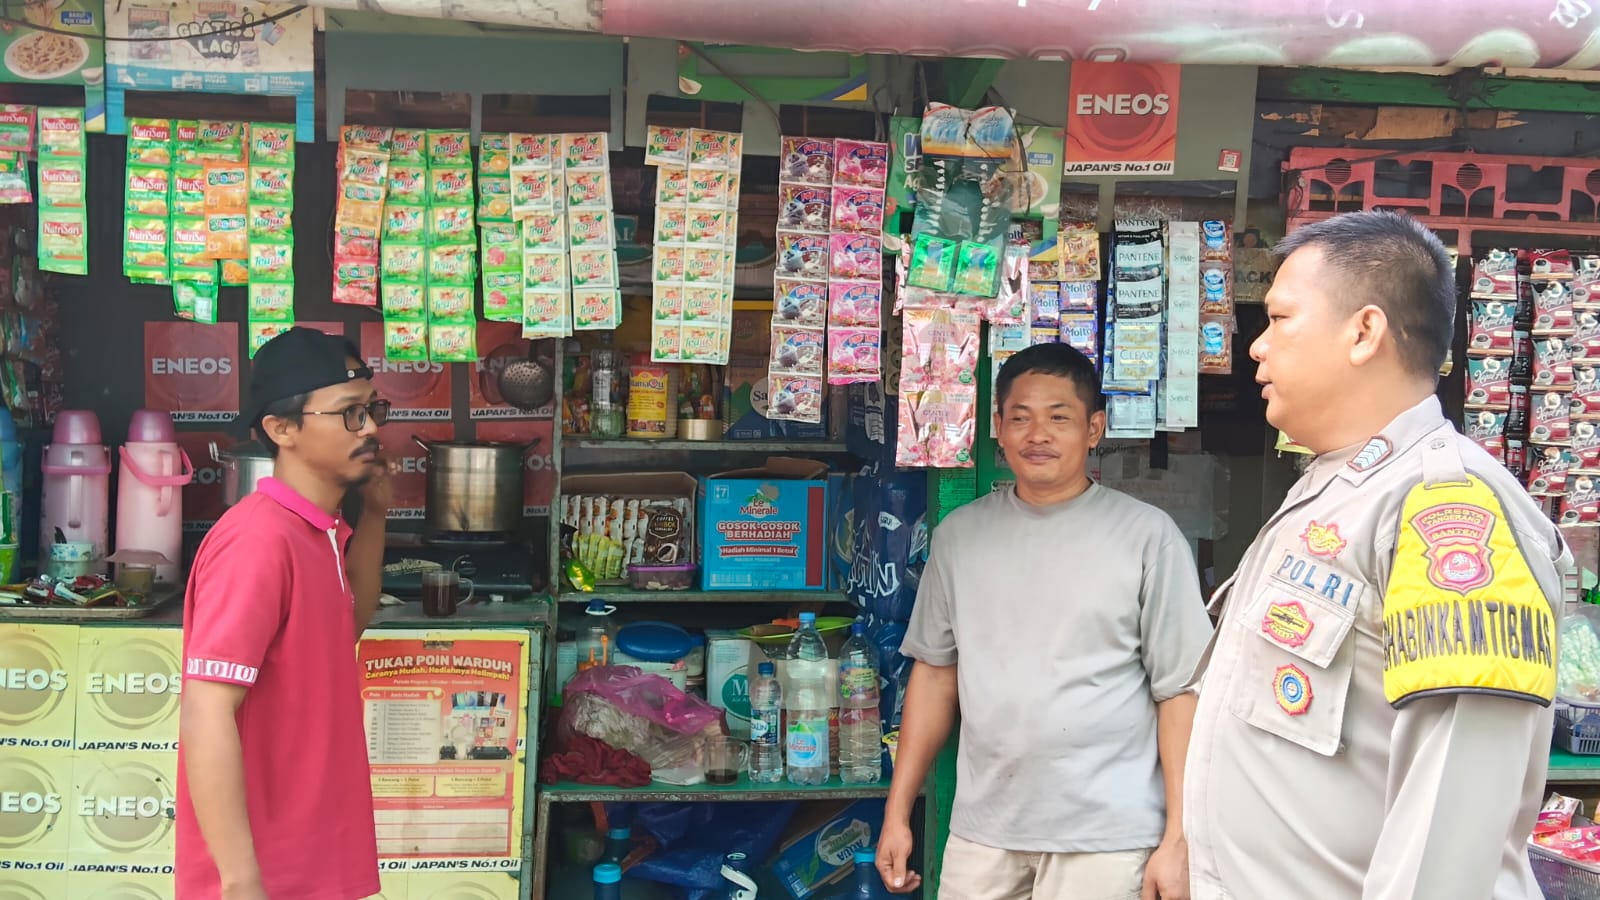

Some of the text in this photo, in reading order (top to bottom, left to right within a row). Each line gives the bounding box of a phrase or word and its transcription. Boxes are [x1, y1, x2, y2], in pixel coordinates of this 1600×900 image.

[1076, 94, 1169, 115] ENEOS
[41, 118, 80, 131] NutriSari
[133, 125, 168, 140] NutriSari
[1066, 162, 1171, 173] JAPAN'S No.1 Oil
[41, 169, 80, 182] NutriSari
[131, 177, 167, 192] NutriSari
[43, 222, 80, 235] NutriSari
[1116, 219, 1158, 227] PANTENE
[129, 229, 165, 241] NutriSari
[1118, 252, 1160, 262] PANTENE
[1234, 270, 1272, 283] ACK
[1118, 289, 1160, 298] PANTENE
[1064, 326, 1092, 336] Molto
[1119, 349, 1154, 360] CLEAR
[152, 357, 232, 375] ENEOS
[367, 356, 444, 374] ENEOS
[171, 412, 237, 420] AN'S No.1 Oil
[411, 409, 449, 417] No.1 Oil
[472, 408, 517, 417] JAPAN'S
[753, 498, 765, 507] Le
[740, 505, 778, 515] Minerale
[1421, 508, 1485, 523] POLRESTA
[1429, 514, 1482, 526] TANGERANG
[718, 522, 800, 531] GOSOK-GOSOK
[726, 531, 791, 539] BERHADIAH
[1431, 528, 1480, 539] BANTEN
[746, 546, 771, 554] Minimal
[1277, 554, 1354, 607] POLRI
[365, 654, 512, 673] TUKAR POIN WARDUH
[365, 670, 398, 679] Caranya
[428, 666, 469, 677] Hadiahnya
[0, 668, 68, 692] NEOS
[86, 672, 182, 694] ENEOS
[20, 739, 49, 747] No.1
[52, 738, 71, 748] Oil
[78, 742, 138, 750] JAPAN'S
[141, 742, 169, 750] No.1
[0, 791, 62, 814] EOS
[14, 861, 43, 870] No.1
[45, 862, 65, 871] Oil
[131, 865, 159, 874] No.1
[388, 861, 407, 870] Oil
[412, 859, 518, 870] JAPAN'S No.1 Oil
